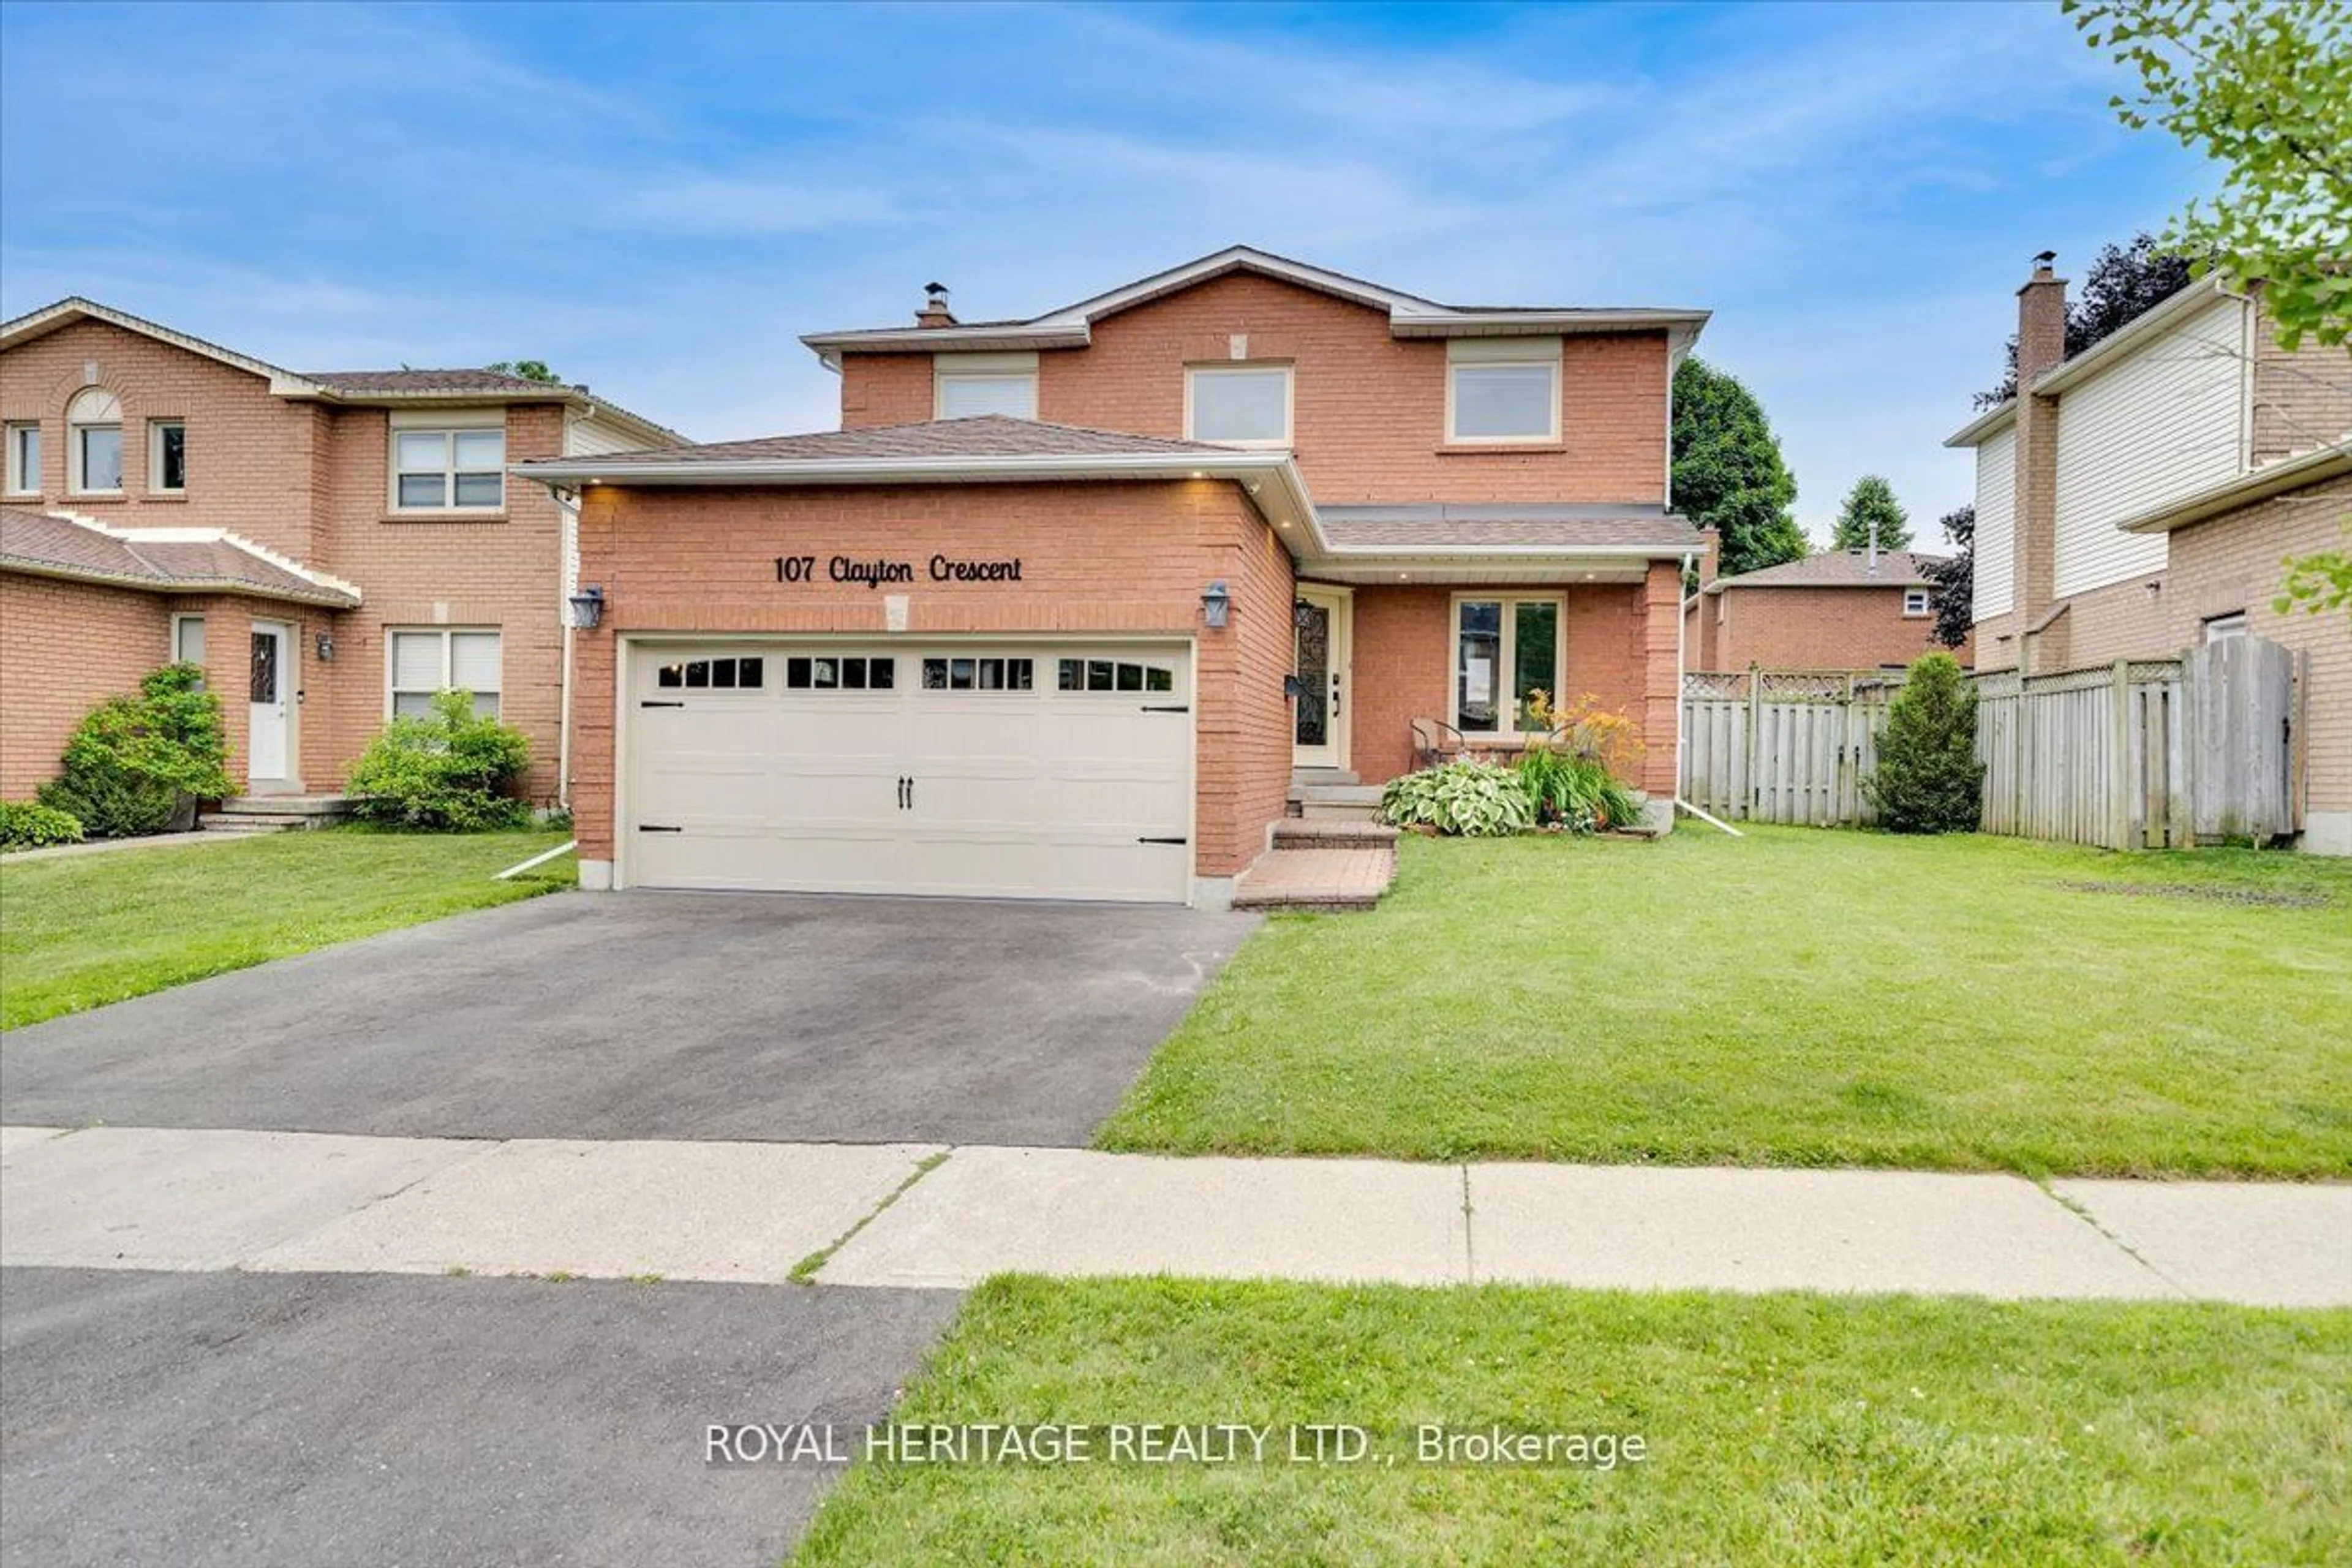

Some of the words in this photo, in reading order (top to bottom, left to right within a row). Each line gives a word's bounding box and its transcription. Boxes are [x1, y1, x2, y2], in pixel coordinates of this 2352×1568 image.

[774, 556, 815, 582] 107
[829, 556, 914, 589] Clayton
[929, 554, 1022, 581] Crescent
